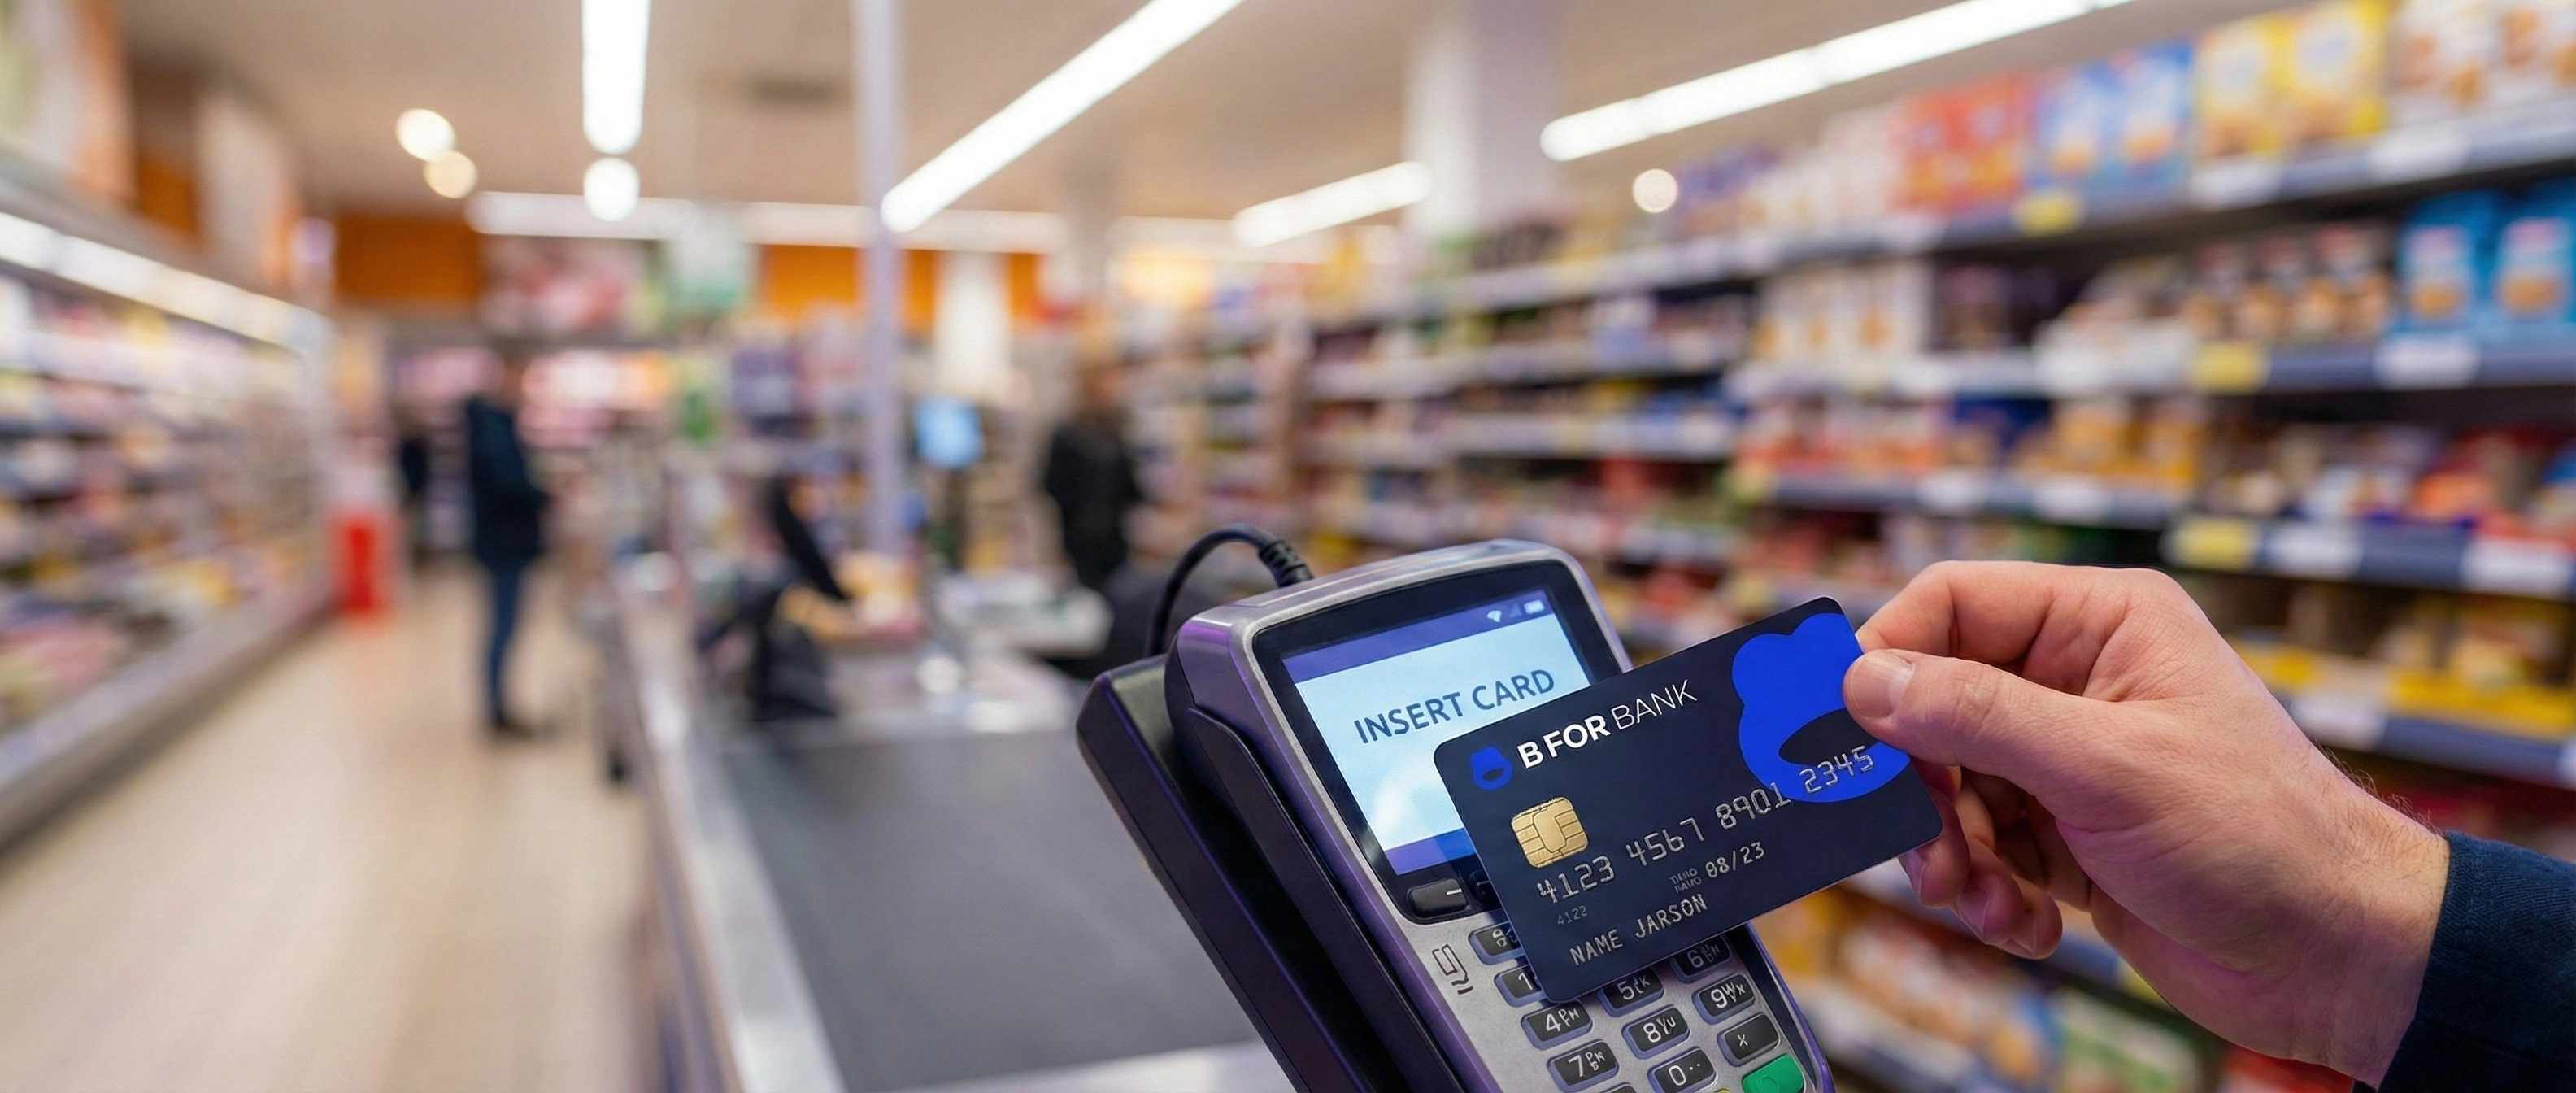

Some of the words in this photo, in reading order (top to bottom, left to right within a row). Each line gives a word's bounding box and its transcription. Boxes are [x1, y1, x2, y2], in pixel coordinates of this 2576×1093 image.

[1353, 691, 1464, 744] INSERT
[1472, 668, 1555, 711] CARD
[1611, 679, 1698, 730] BANK
[1536, 856, 1616, 904] 4123
[1625, 817, 1705, 867] 4567
[1715, 782, 1791, 830] 8901
[1799, 745, 1874, 795] 2345
[1556, 904, 1588, 925] 4122
[1569, 929, 1624, 966] NAME
[1634, 893, 1708, 938] JARSON
